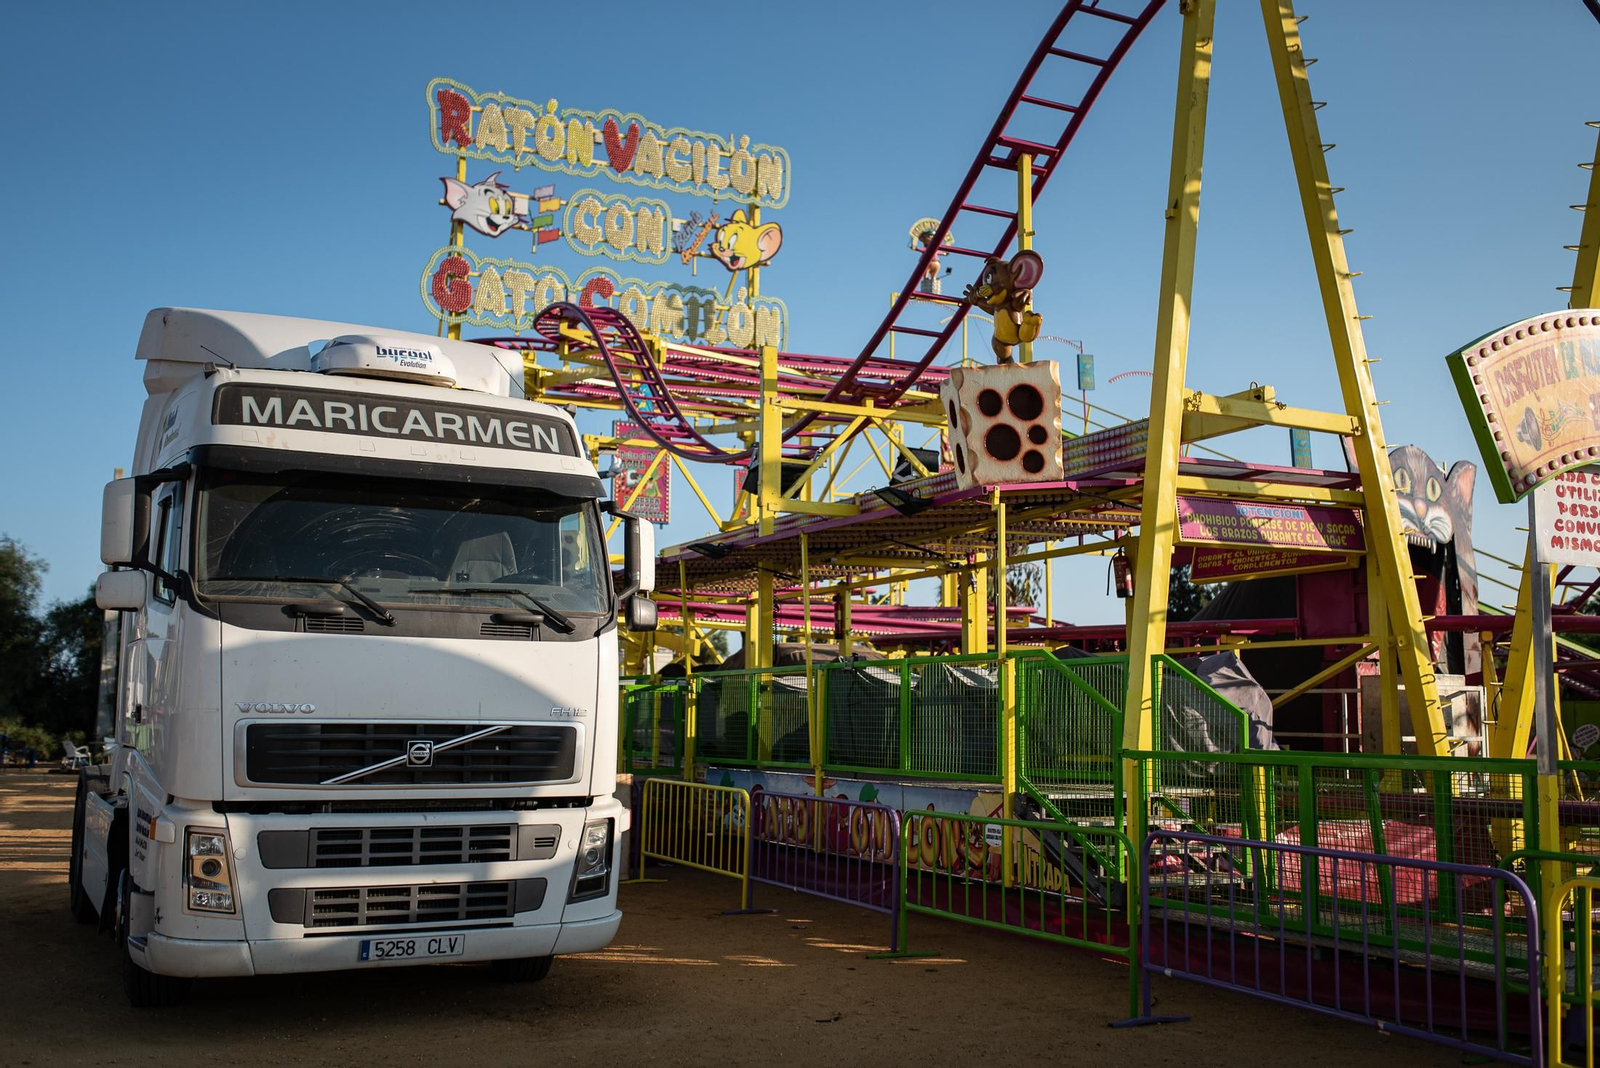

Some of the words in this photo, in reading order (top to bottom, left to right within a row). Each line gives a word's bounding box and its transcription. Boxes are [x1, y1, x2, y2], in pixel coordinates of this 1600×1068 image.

[572, 198, 664, 256] CON
[376, 346, 433, 362] bycool
[400, 360, 427, 369] Evolution
[241, 394, 560, 454] MARICARMEN
[1556, 485, 1600, 502] UTILI
[1557, 502, 1600, 518] PERS
[1187, 512, 1238, 528] PROHIBIDO
[1240, 517, 1284, 531] PONERSE
[1285, 520, 1298, 531] DE
[1301, 521, 1316, 533] PIE
[1317, 523, 1324, 533] Y
[1326, 523, 1356, 535] SACAR
[1199, 525, 1219, 538] LOS
[1221, 527, 1259, 540] BRAZOS
[1261, 529, 1303, 544] DURANTE
[1305, 532, 1319, 544] EL
[1321, 533, 1348, 546] VIAJE
[1233, 557, 1298, 571] COMPLEMENTOS
[235, 702, 316, 714] VOLVO
[375, 940, 416, 958] 5258
[427, 937, 458, 954] CLV
